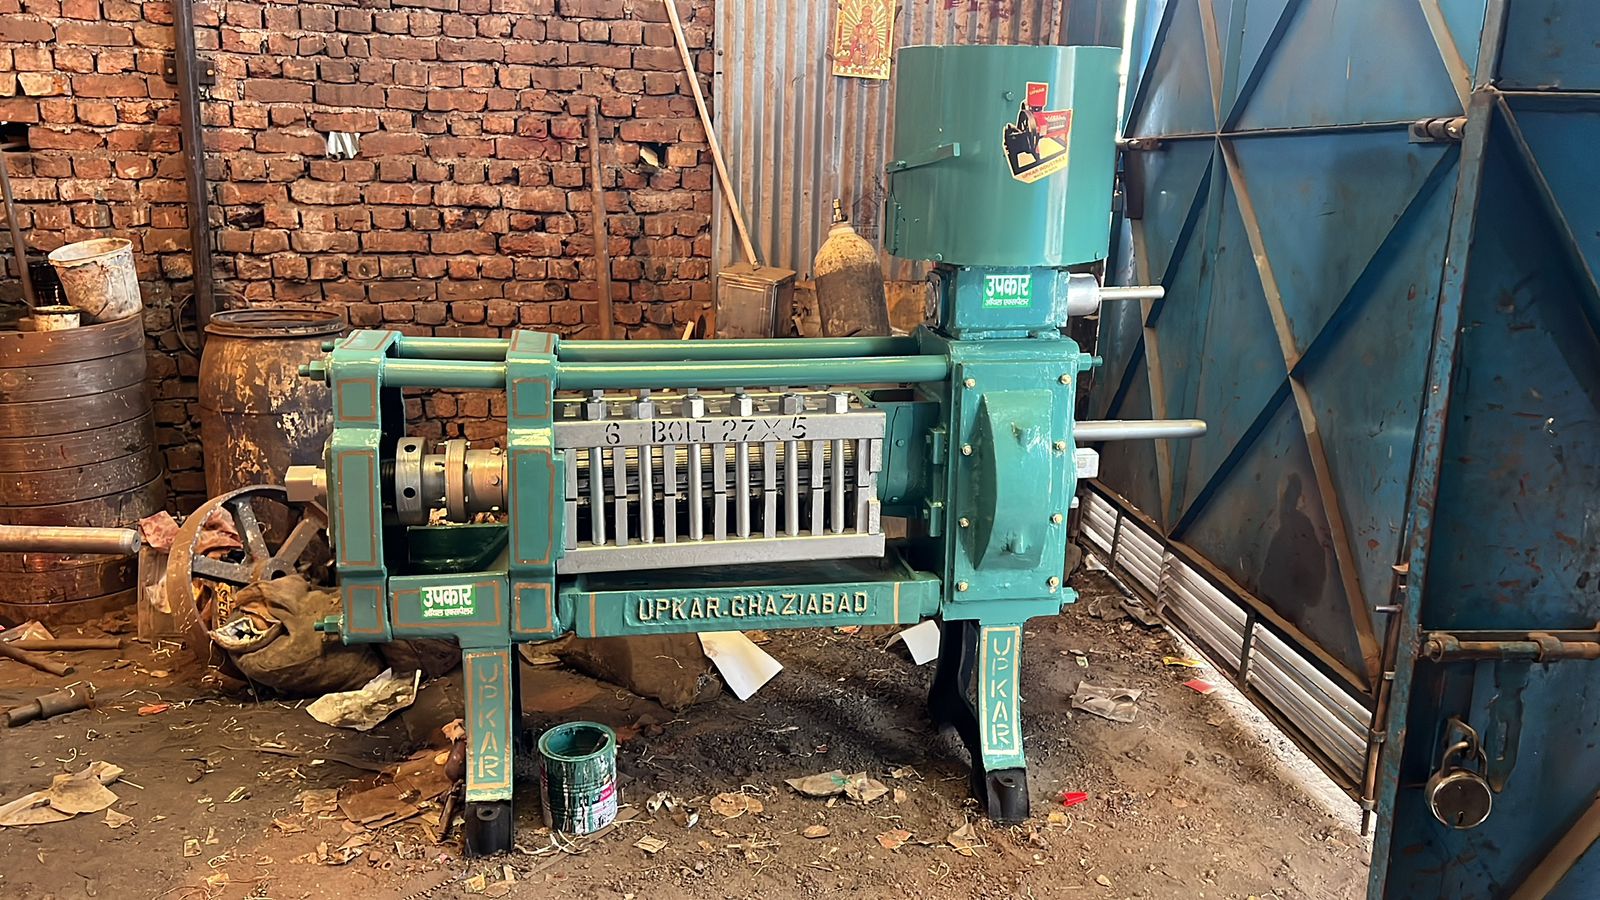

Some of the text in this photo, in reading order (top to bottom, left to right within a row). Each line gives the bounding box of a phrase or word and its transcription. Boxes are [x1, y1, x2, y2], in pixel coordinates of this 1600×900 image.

[985, 274, 1031, 297] उपकार
[605, 422, 620, 445] 6
[651, 419, 712, 443] BOLT
[421, 584, 473, 608] उपकार
[990, 636, 1011, 746] UPKAR
[478, 663, 499, 778] UPKAR
